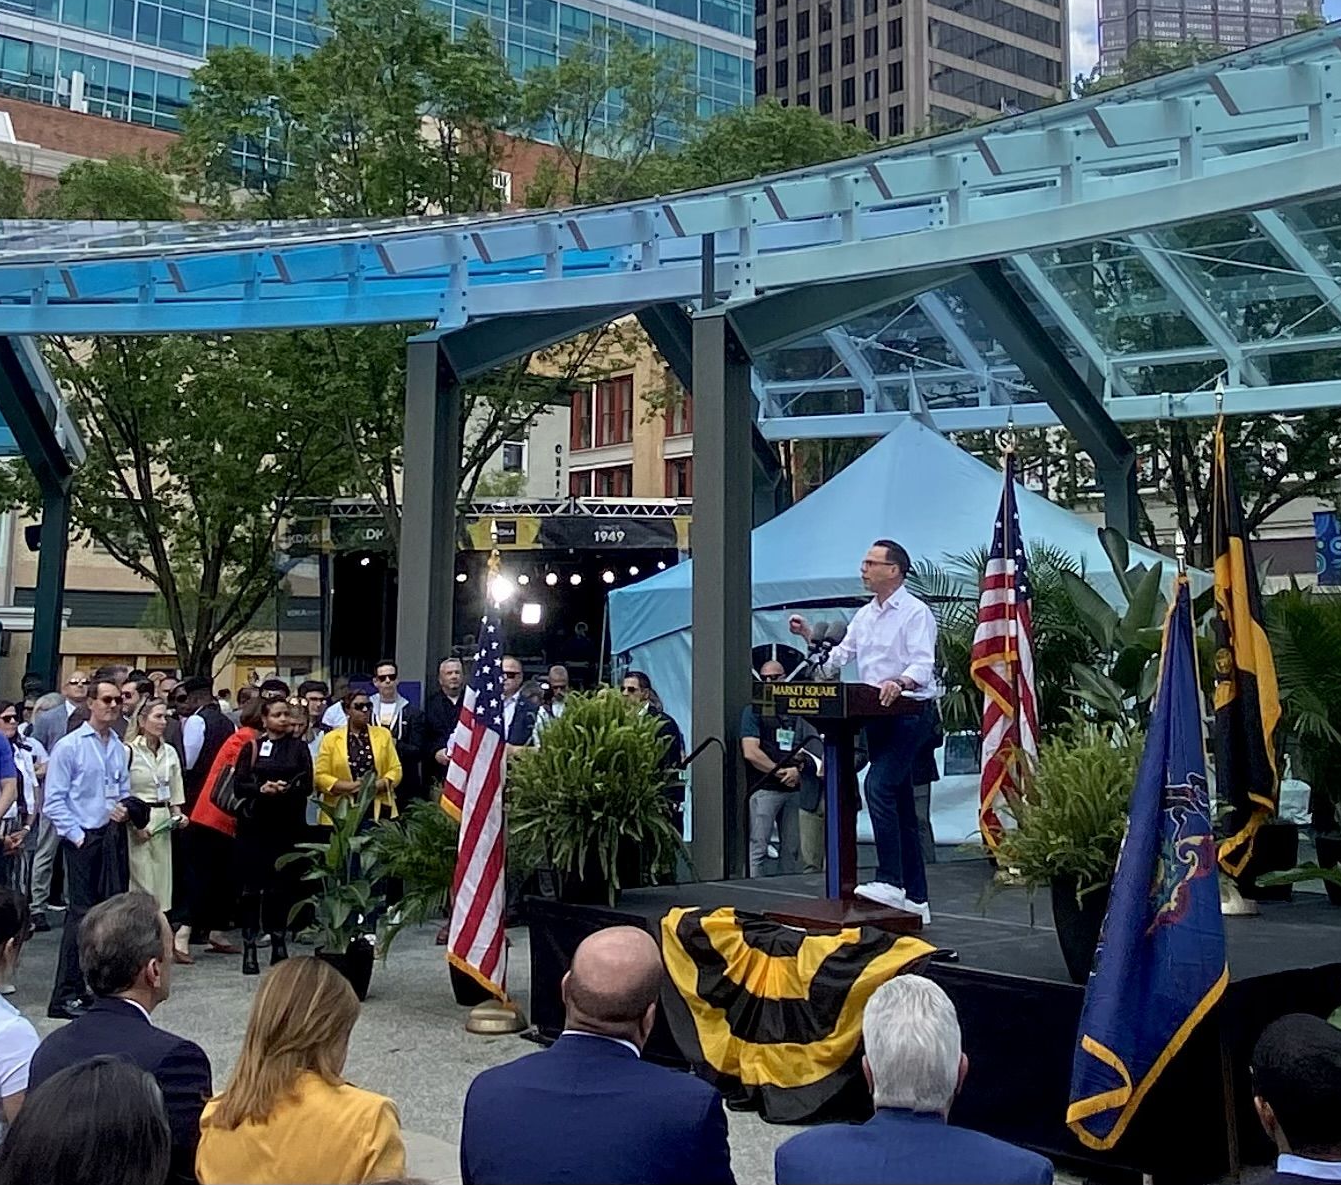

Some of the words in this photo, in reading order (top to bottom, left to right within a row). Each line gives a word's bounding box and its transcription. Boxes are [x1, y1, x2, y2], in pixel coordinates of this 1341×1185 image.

[594, 530, 626, 543] 1949
[772, 684, 804, 696] MARKET
[798, 697, 820, 709] OPEN
